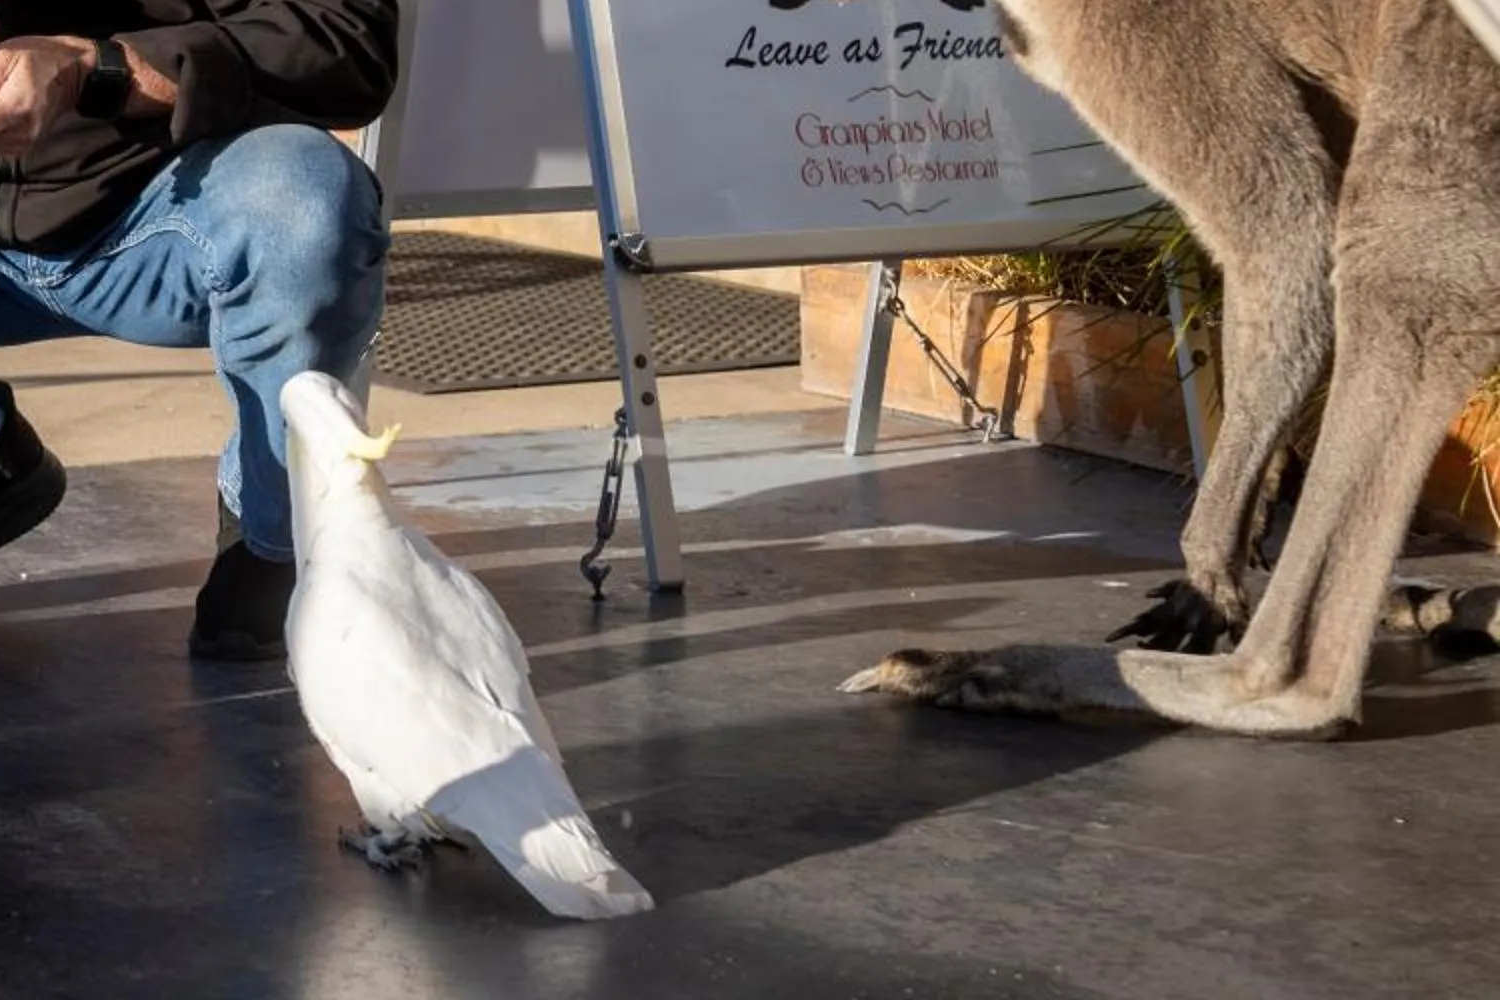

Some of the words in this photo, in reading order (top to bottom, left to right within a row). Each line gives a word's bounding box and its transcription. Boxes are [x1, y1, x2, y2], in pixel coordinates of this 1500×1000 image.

[724, 26, 829, 68] Leave
[843, 37, 883, 62] as
[795, 113, 927, 155] Grampians
[827, 157, 886, 186] Views
[887, 153, 999, 184] Restaurant
